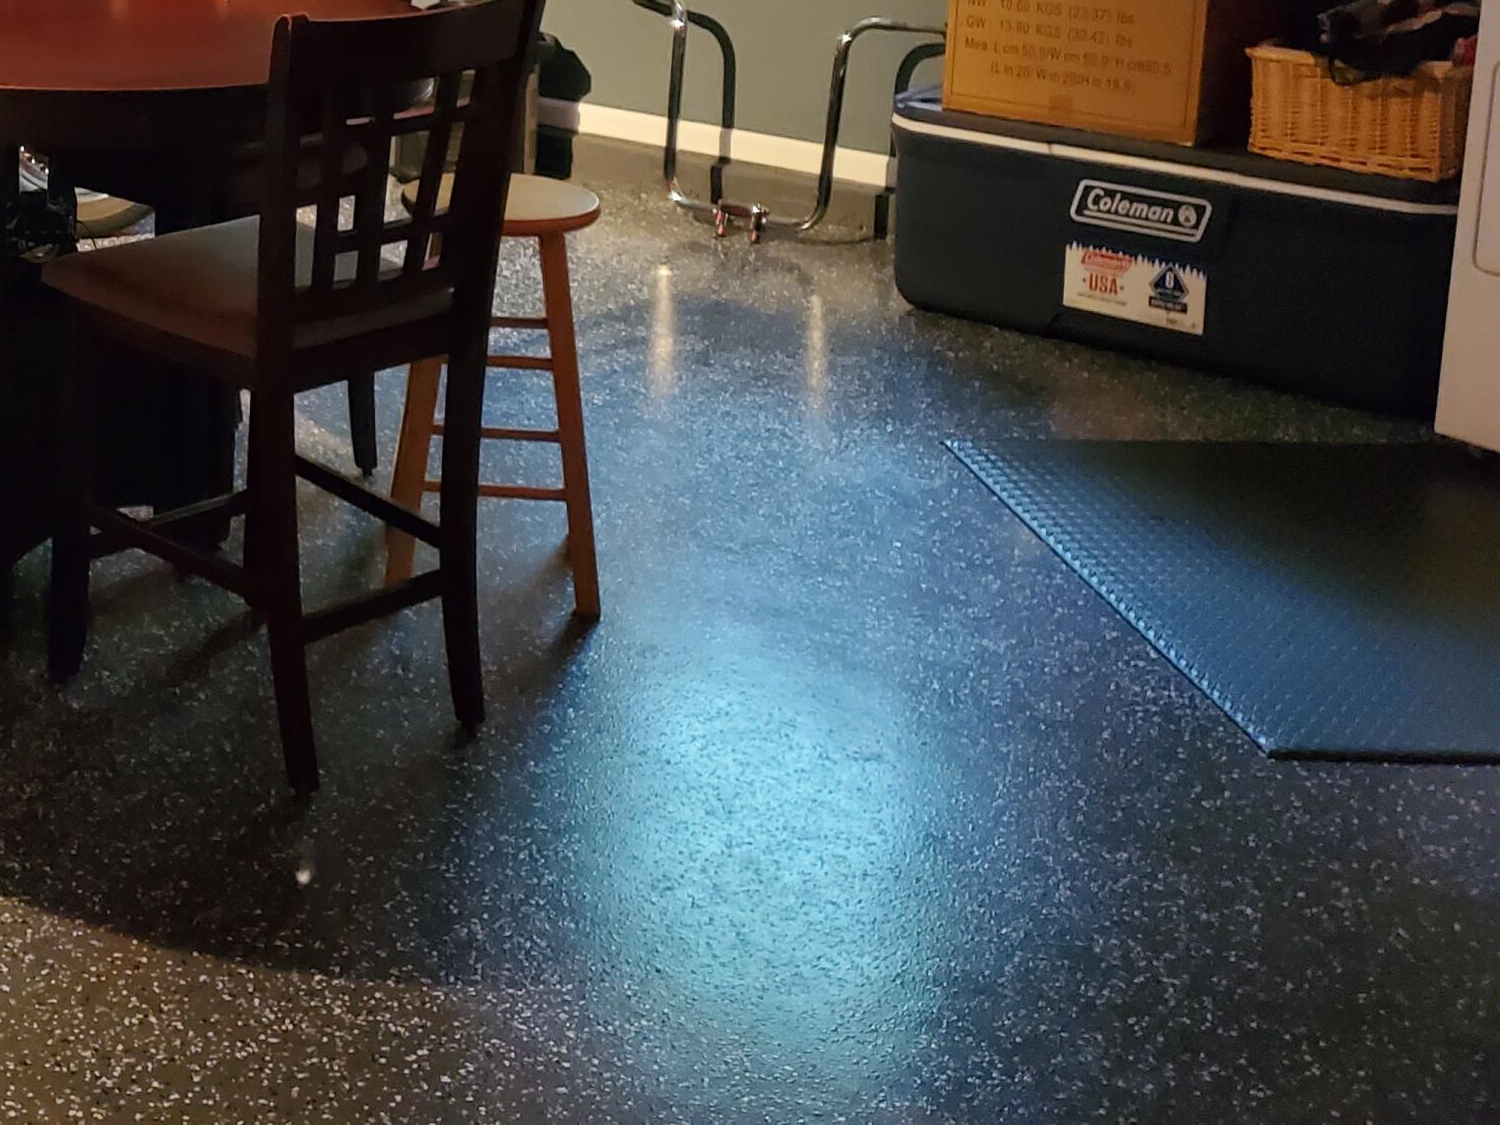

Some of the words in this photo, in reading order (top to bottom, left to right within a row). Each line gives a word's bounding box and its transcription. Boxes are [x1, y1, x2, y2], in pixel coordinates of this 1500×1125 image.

[1036, 2, 1062, 16] KGS
[1086, 188, 1175, 223] Coleman
[1088, 272, 1119, 295] USA
